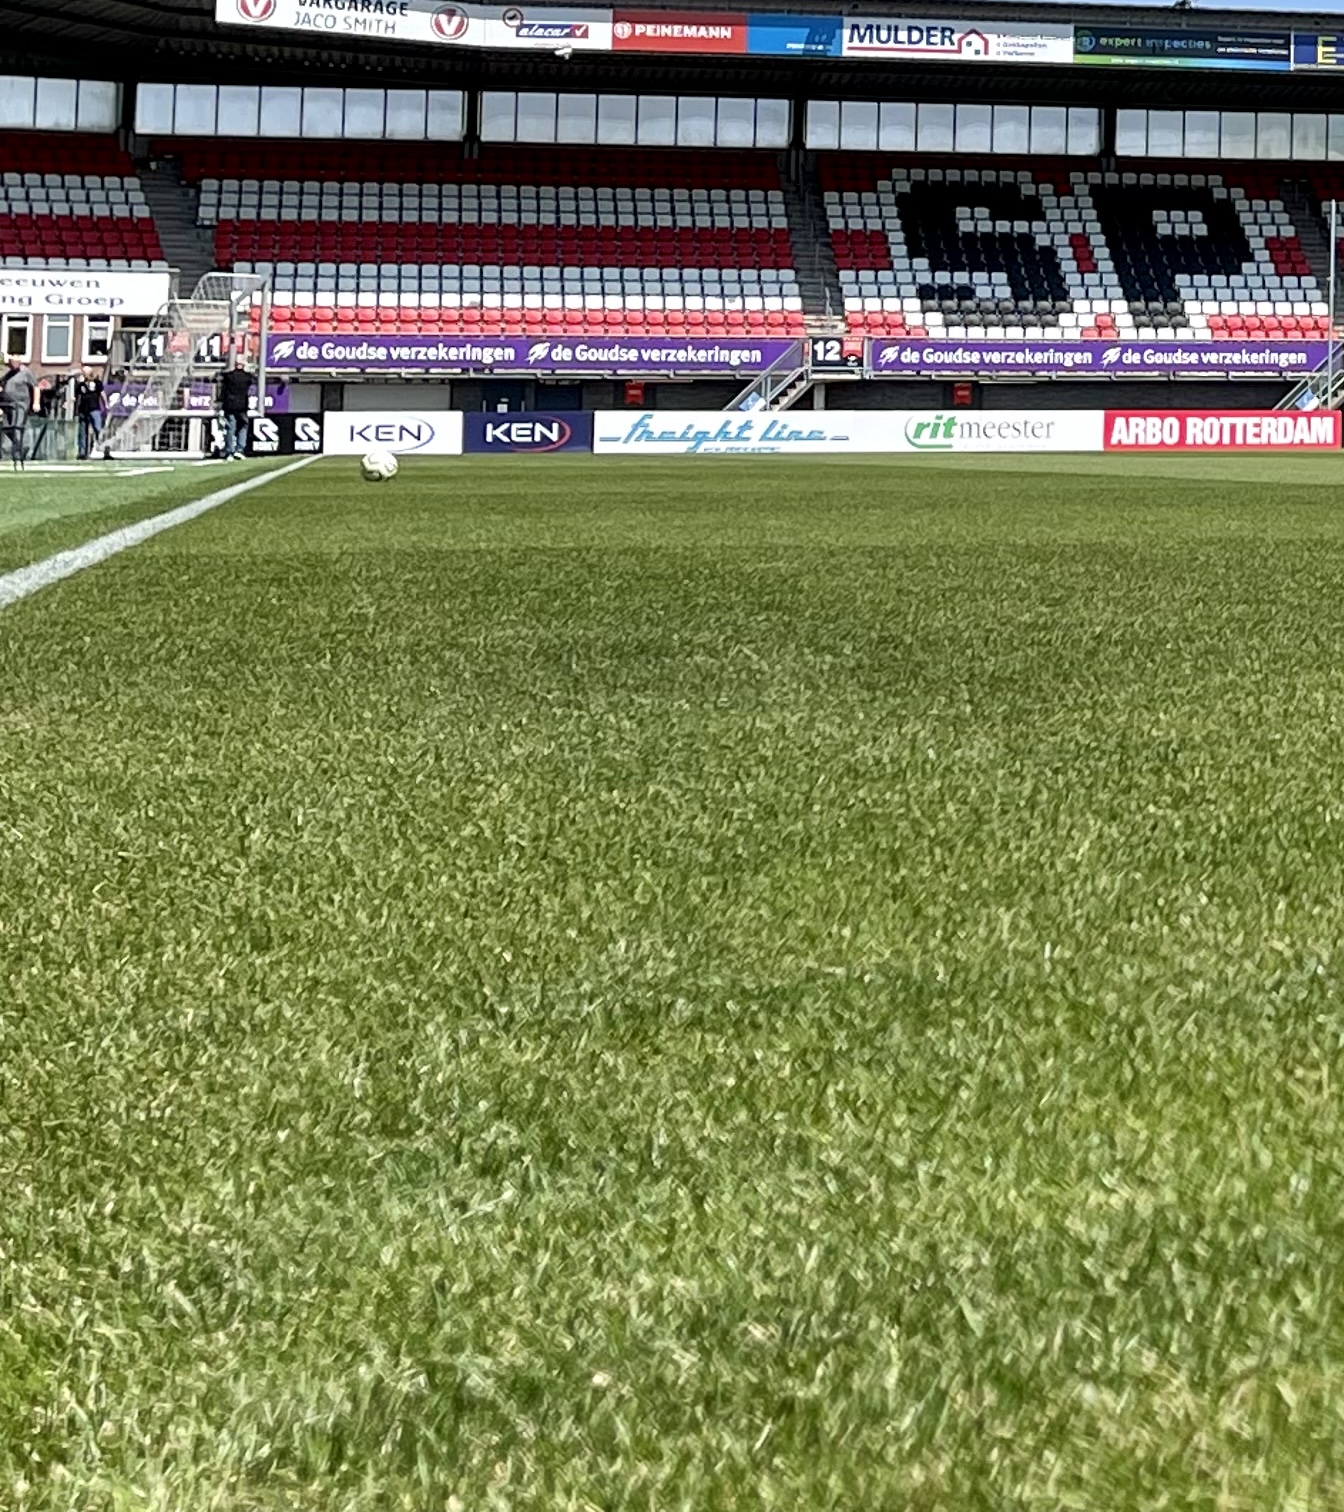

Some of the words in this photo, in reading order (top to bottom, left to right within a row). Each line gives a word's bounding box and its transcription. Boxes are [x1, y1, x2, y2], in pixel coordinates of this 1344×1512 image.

[294, 11, 336, 30] JACO
[343, 16, 396, 35] SMITH
[635, 23, 732, 39] PEINEMANN
[848, 23, 956, 46] MULDER
[45, 293, 124, 309] Groep
[296, 341, 318, 360] de
[321, 342, 386, 361] Goudse
[389, 344, 515, 366] verzekeringen
[551, 344, 571, 362] de
[575, 344, 637, 363] Goudse
[640, 346, 762, 367] verzekeringen
[814, 340, 841, 361] 12
[900, 346, 920, 363] de
[922, 347, 980, 364] Goudse
[983, 348, 1093, 367] verzekeringen
[1122, 346, 1141, 364] de
[1144, 347, 1200, 365] Goudse
[1203, 349, 1307, 368] verzekeringen
[349, 424, 424, 442] KEN
[486, 422, 560, 443] KEN
[913, 414, 1055, 439] ritmeester
[1111, 417, 1179, 446] ARBO
[1185, 416, 1333, 446] ROTTERDAM
